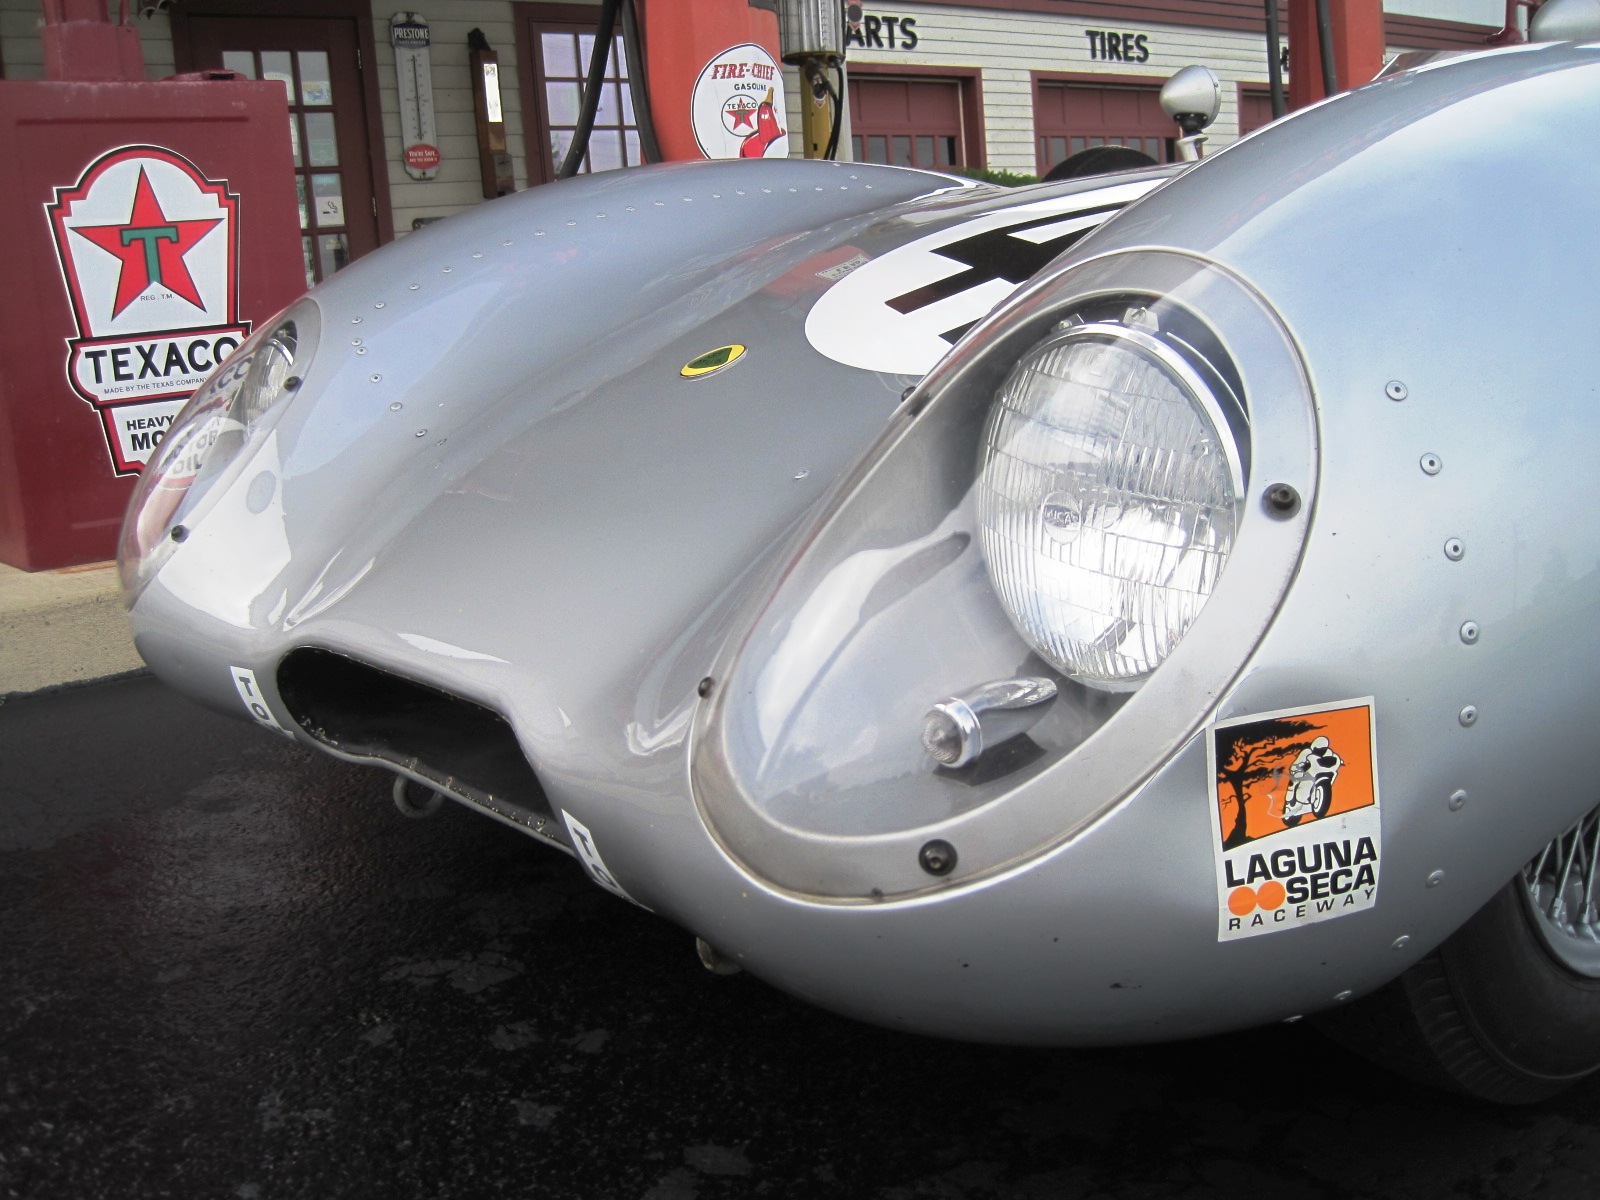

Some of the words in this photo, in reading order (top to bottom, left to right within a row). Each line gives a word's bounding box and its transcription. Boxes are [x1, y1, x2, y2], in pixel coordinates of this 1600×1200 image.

[393, 27, 429, 39] PRESTONE
[845, 15, 919, 50] ARTS
[1085, 29, 1150, 63] TIRES
[710, 62, 776, 81] FIRE-CHIEF
[733, 82, 768, 92] GASOLINE
[727, 102, 757, 110] TEXACO
[119, 226, 179, 285] T
[85, 336, 239, 385] TEXACO
[103, 386, 125, 395] MADE
[136, 383, 150, 391] THE
[152, 381, 174, 389] TEXAS
[126, 414, 175, 432] HEAVY
[1224, 836, 1378, 889] LAGUNA
[1285, 863, 1376, 906] SECA
[1228, 887, 1375, 931] RACEWAY
